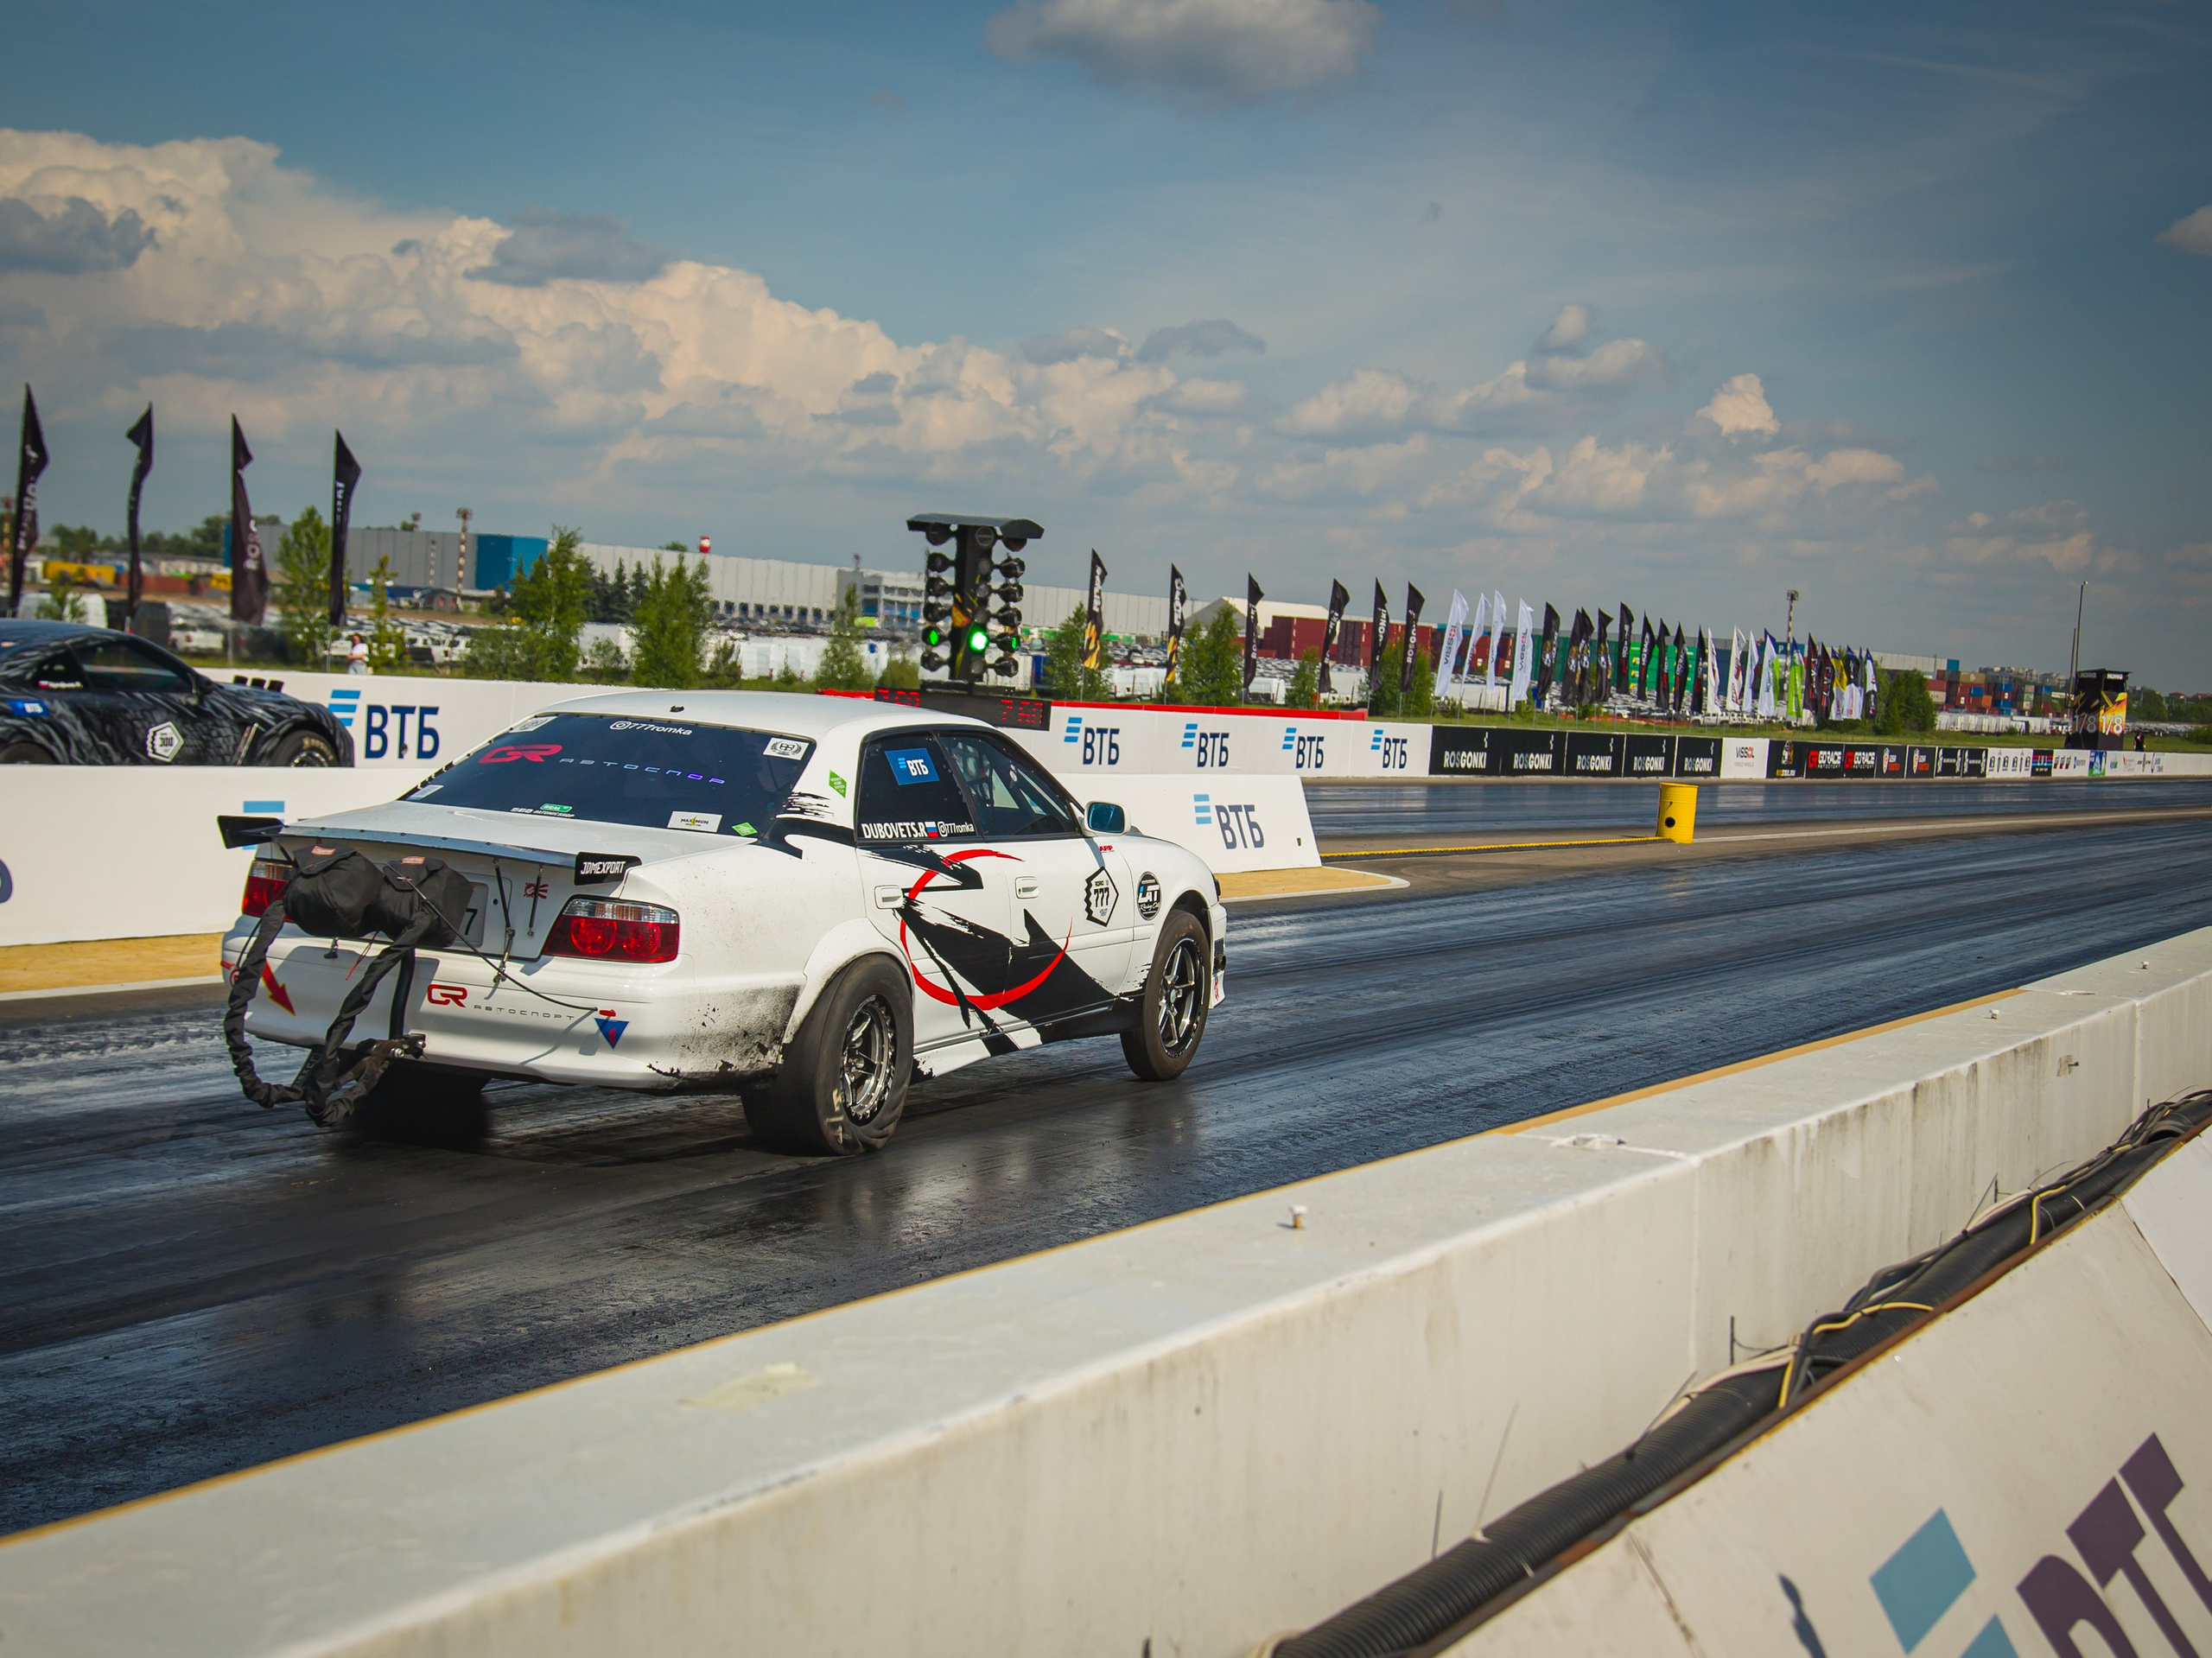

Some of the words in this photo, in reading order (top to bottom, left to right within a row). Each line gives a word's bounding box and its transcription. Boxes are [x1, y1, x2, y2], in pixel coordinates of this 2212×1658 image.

[364, 704, 441, 759] ВТБ
[2101, 714, 2123, 735] 1/8
[1083, 727, 1121, 765] ВТБ
[1197, 732, 1230, 768] ВТБ
[1295, 735, 1325, 769] ВТБ
[1382, 737, 1408, 769] ВТБ
[906, 759, 930, 777] ВТБ
[1443, 750, 1487, 769] ROSGONKI
[1513, 753, 1553, 770] ROSGONKI
[1576, 754, 1613, 771] ROSGONKI
[1633, 756, 1666, 772] ROSGONKI
[1683, 757, 1713, 772] ROSGONKI
[861, 821, 929, 840] DUBOVETS.R
[1215, 804, 1265, 850] ВТБ
[580, 861, 626, 875] JDMEXPORT
[1093, 886, 1110, 908] 777
